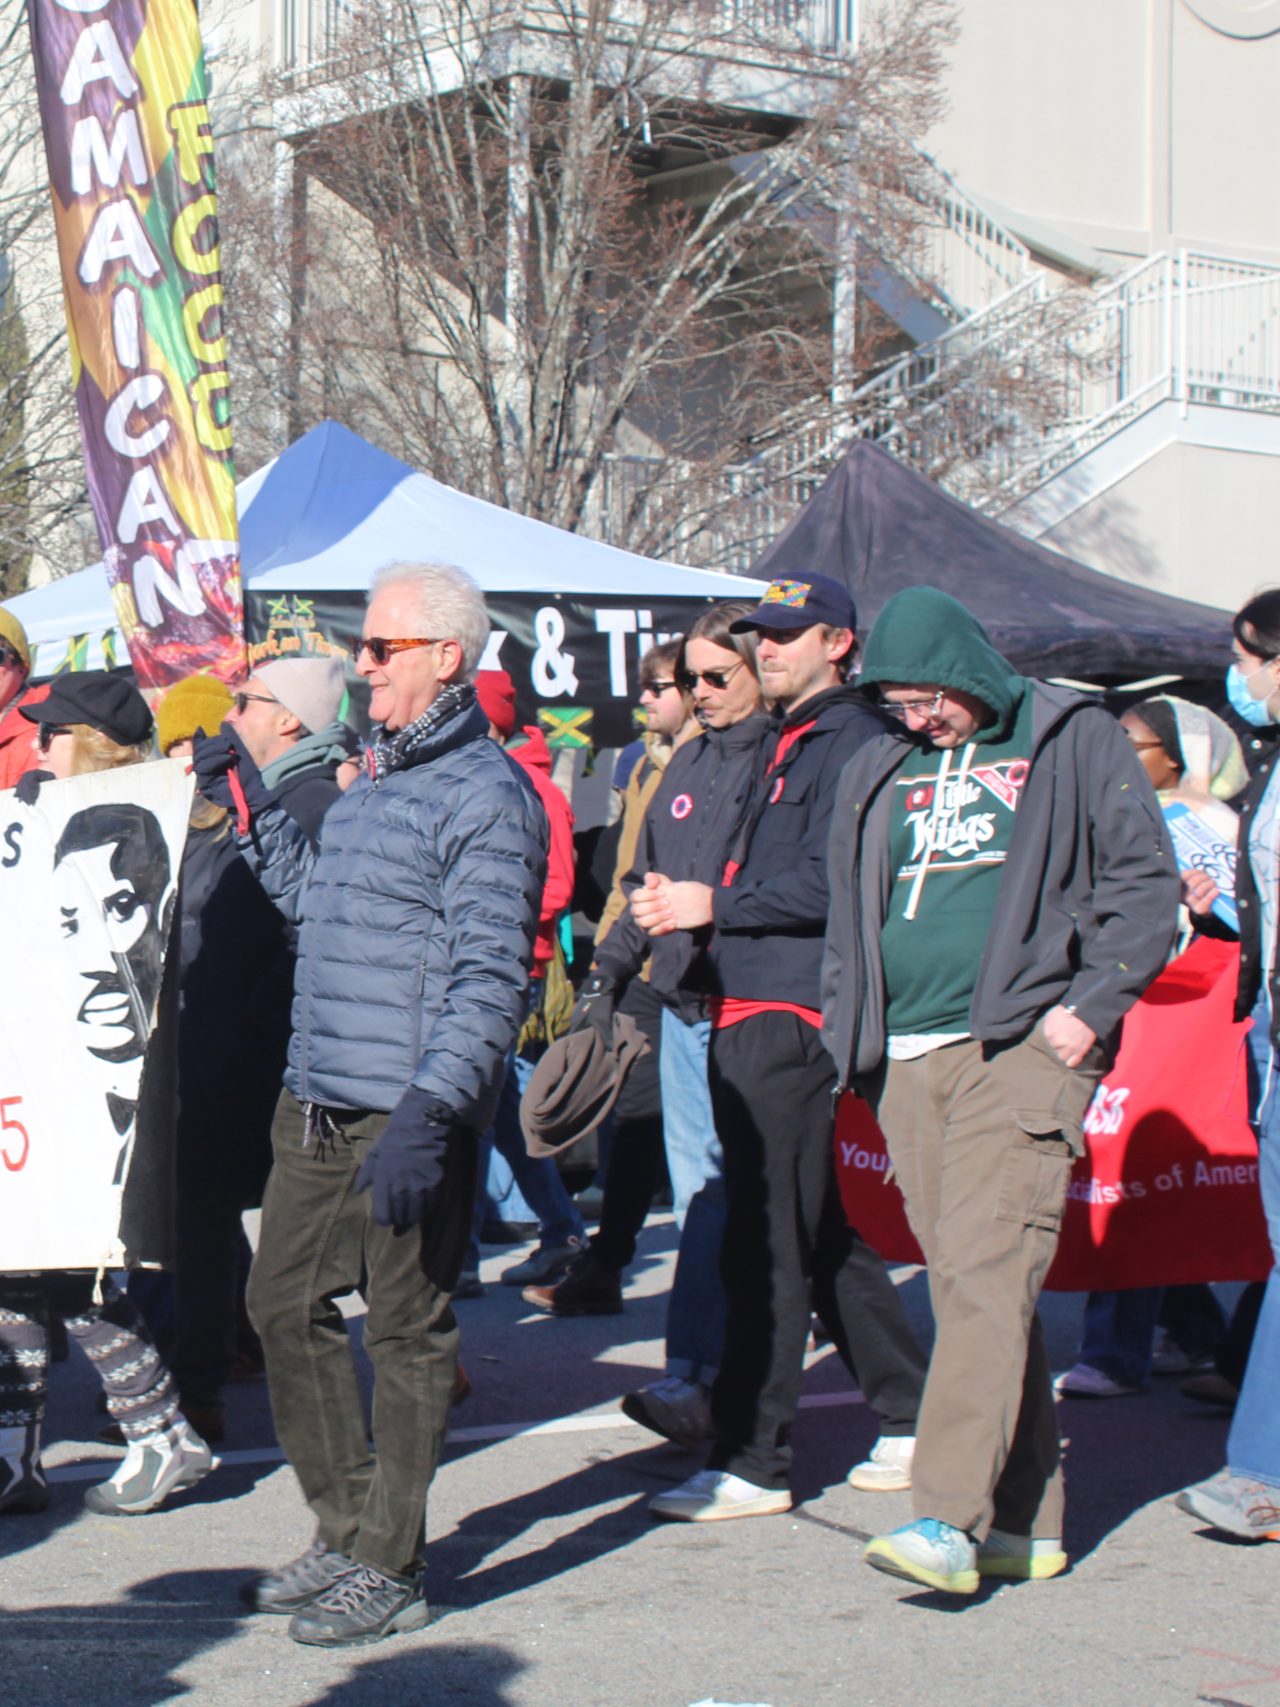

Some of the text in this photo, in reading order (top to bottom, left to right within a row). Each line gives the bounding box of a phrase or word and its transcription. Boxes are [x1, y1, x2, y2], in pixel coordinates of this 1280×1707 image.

[54, 0, 208, 628] AMAICAN
[531, 606, 580, 699] &
[904, 808, 998, 857] Kings
[840, 1141, 893, 1172] You
[1154, 1163, 1184, 1190] of
[1195, 1160, 1258, 1186] Amer
